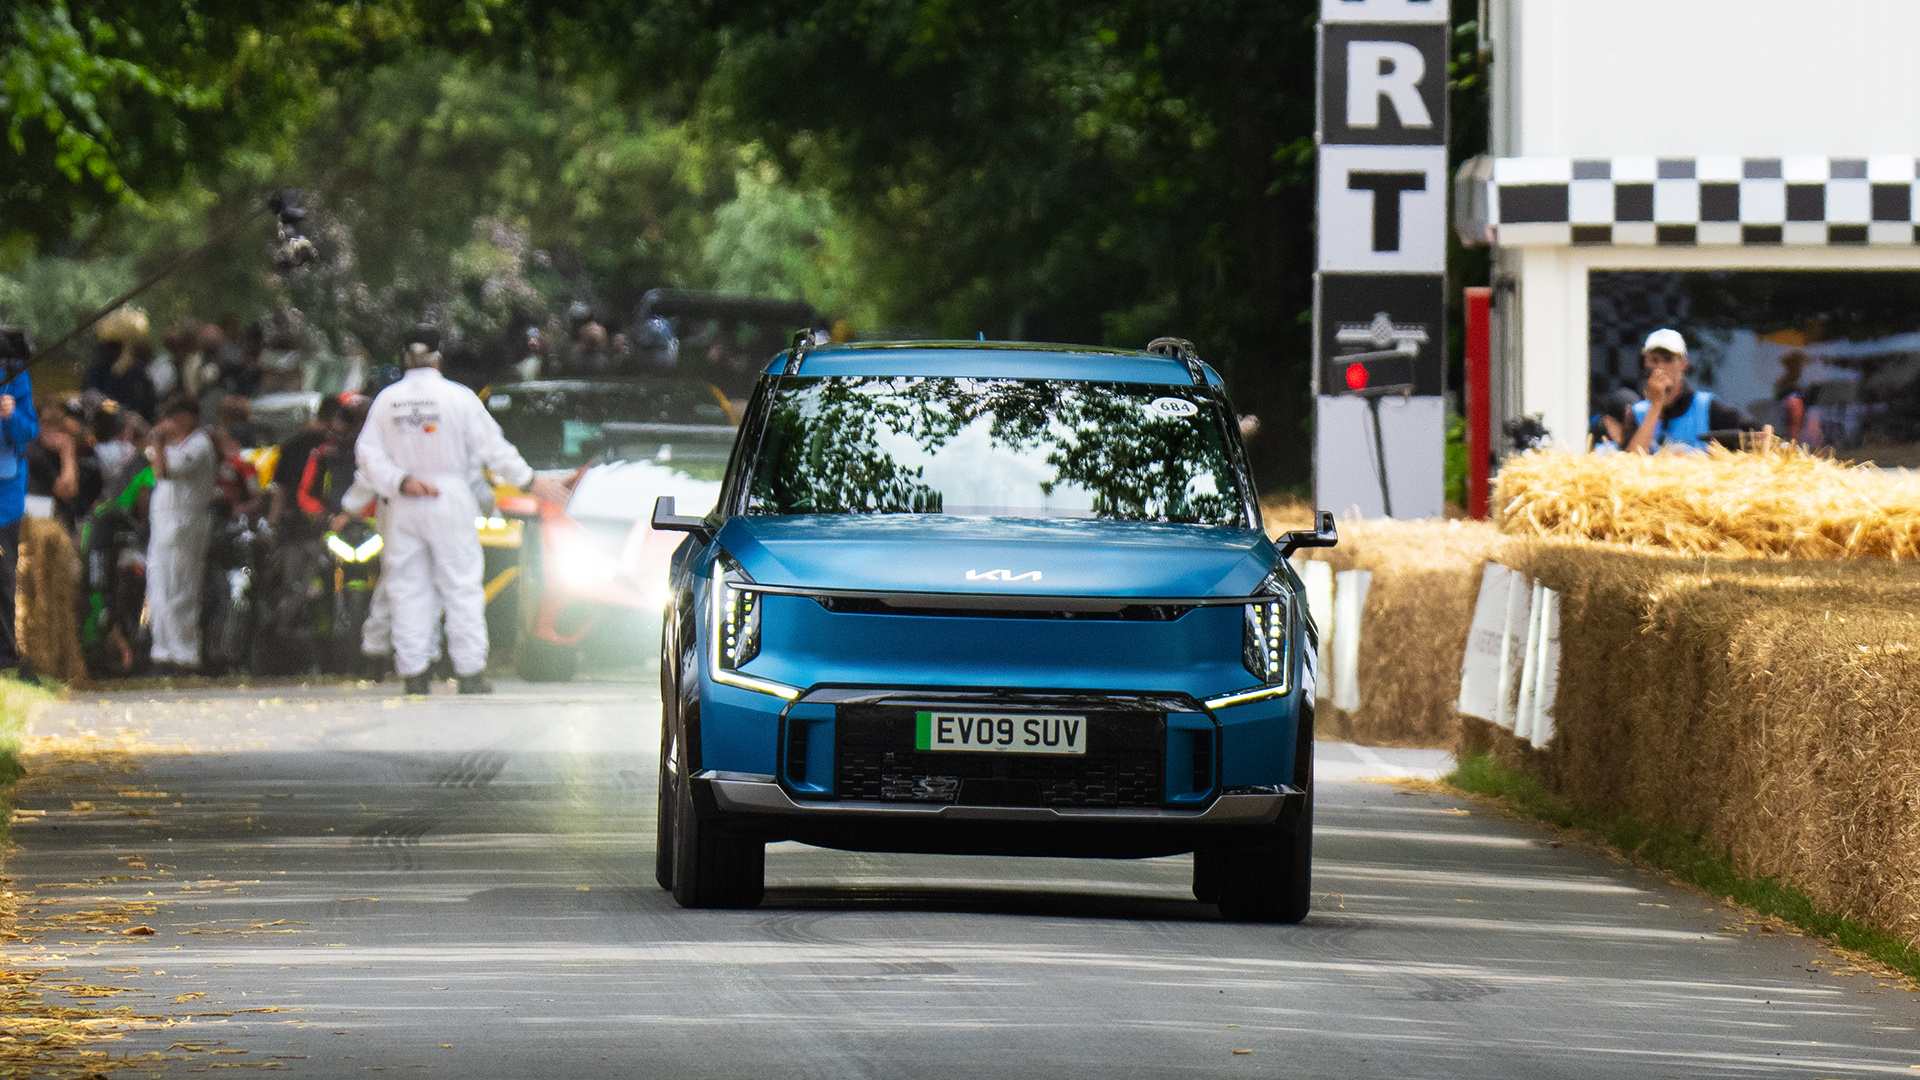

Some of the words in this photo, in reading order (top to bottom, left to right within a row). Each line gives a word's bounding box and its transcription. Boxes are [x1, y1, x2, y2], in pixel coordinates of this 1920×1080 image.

[1342, 0, 1433, 252] RT
[1160, 402, 1190, 412] 684
[937, 716, 1014, 745] EV09
[1023, 718, 1079, 747] SUV
